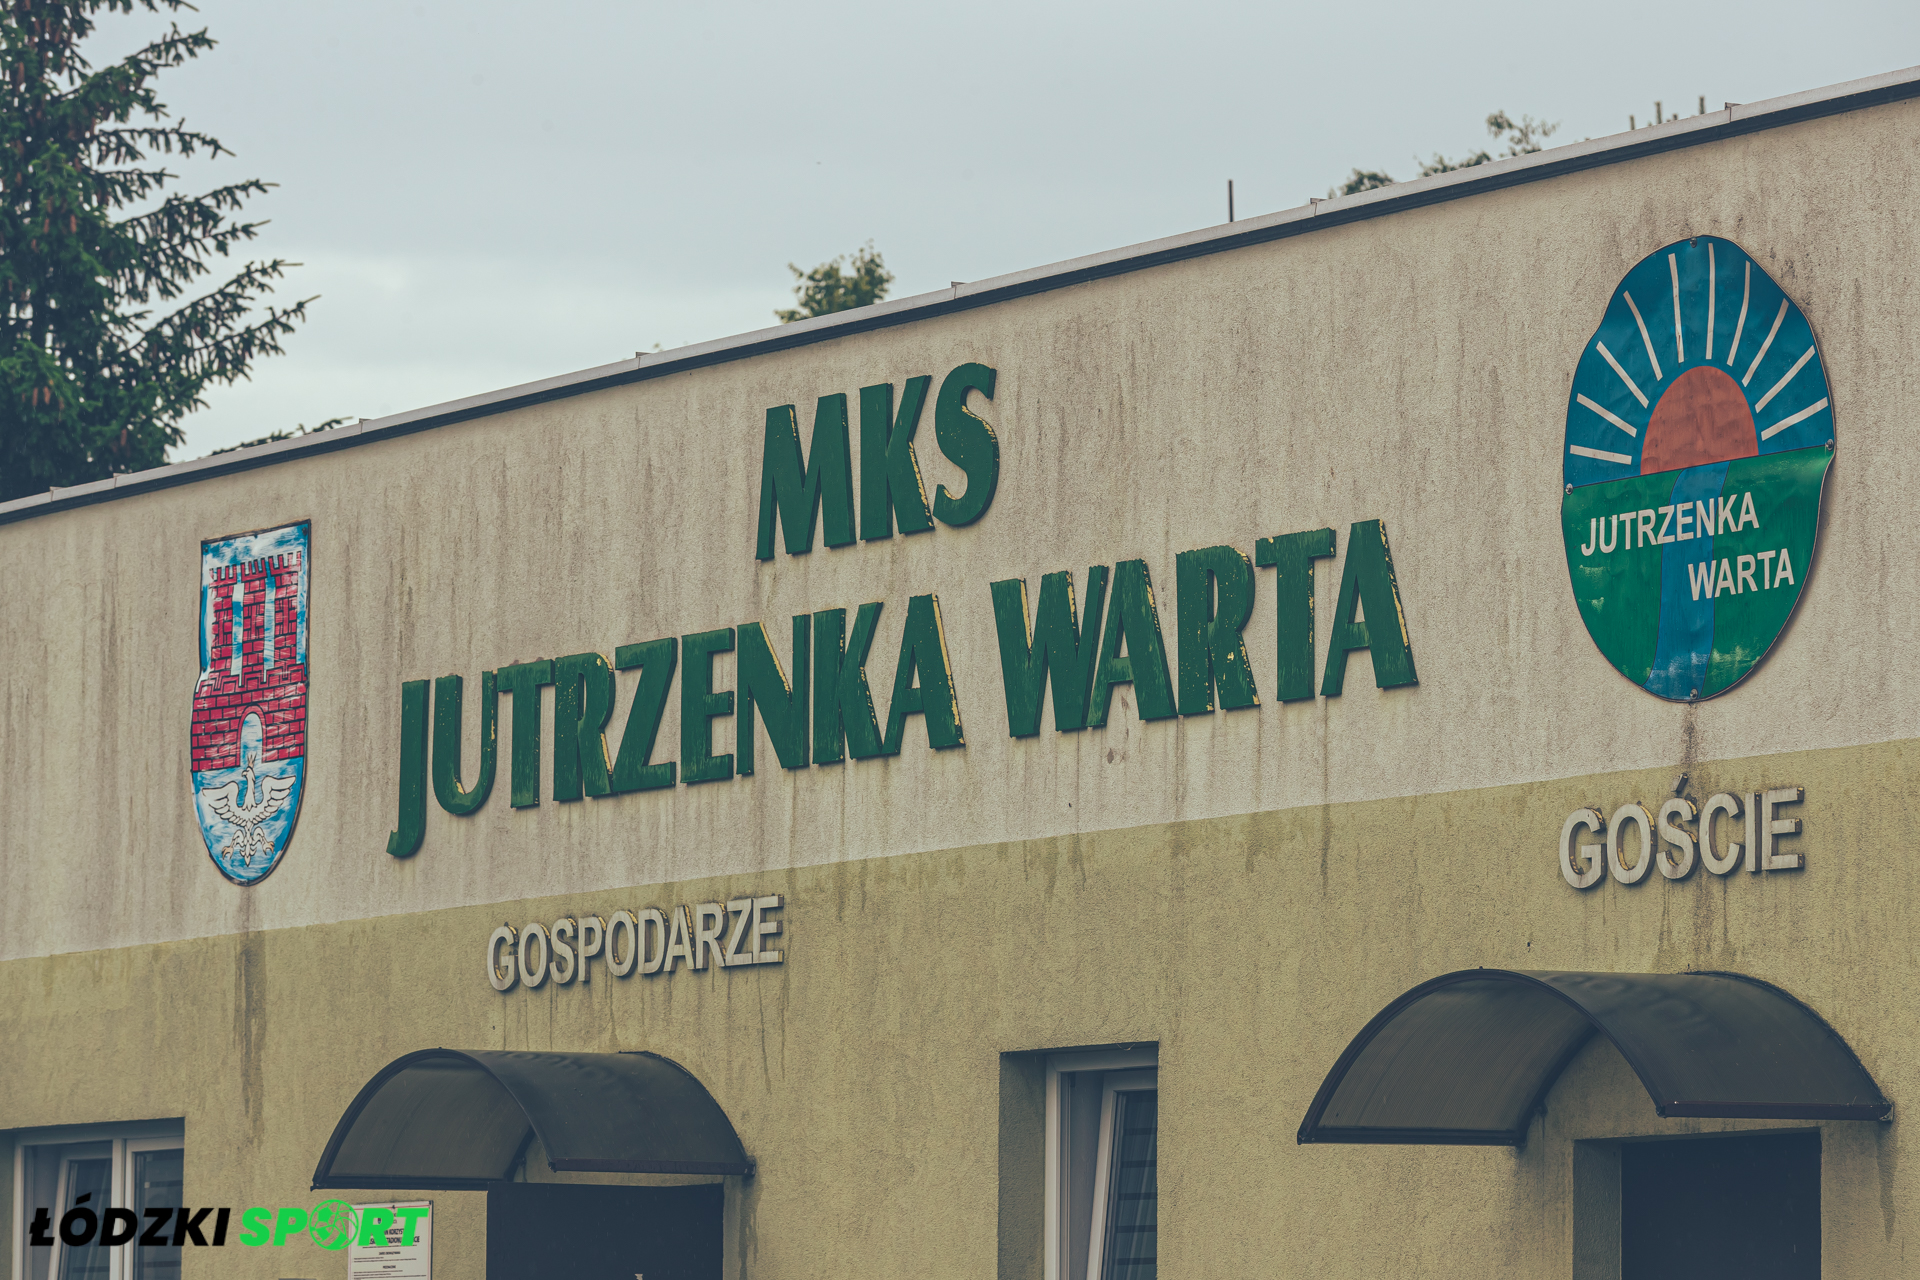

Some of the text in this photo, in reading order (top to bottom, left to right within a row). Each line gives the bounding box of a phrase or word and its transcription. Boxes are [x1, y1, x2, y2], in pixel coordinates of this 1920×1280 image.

[756, 362, 1000, 561] MKS
[1581, 492, 1759, 556] JUTRZENKA
[1688, 548, 1794, 601] WARTA
[386, 518, 1419, 859] JUTRZENKA WARTA
[1559, 773, 1804, 889] GOŚCIE
[487, 894, 784, 991] GOSPODARZE
